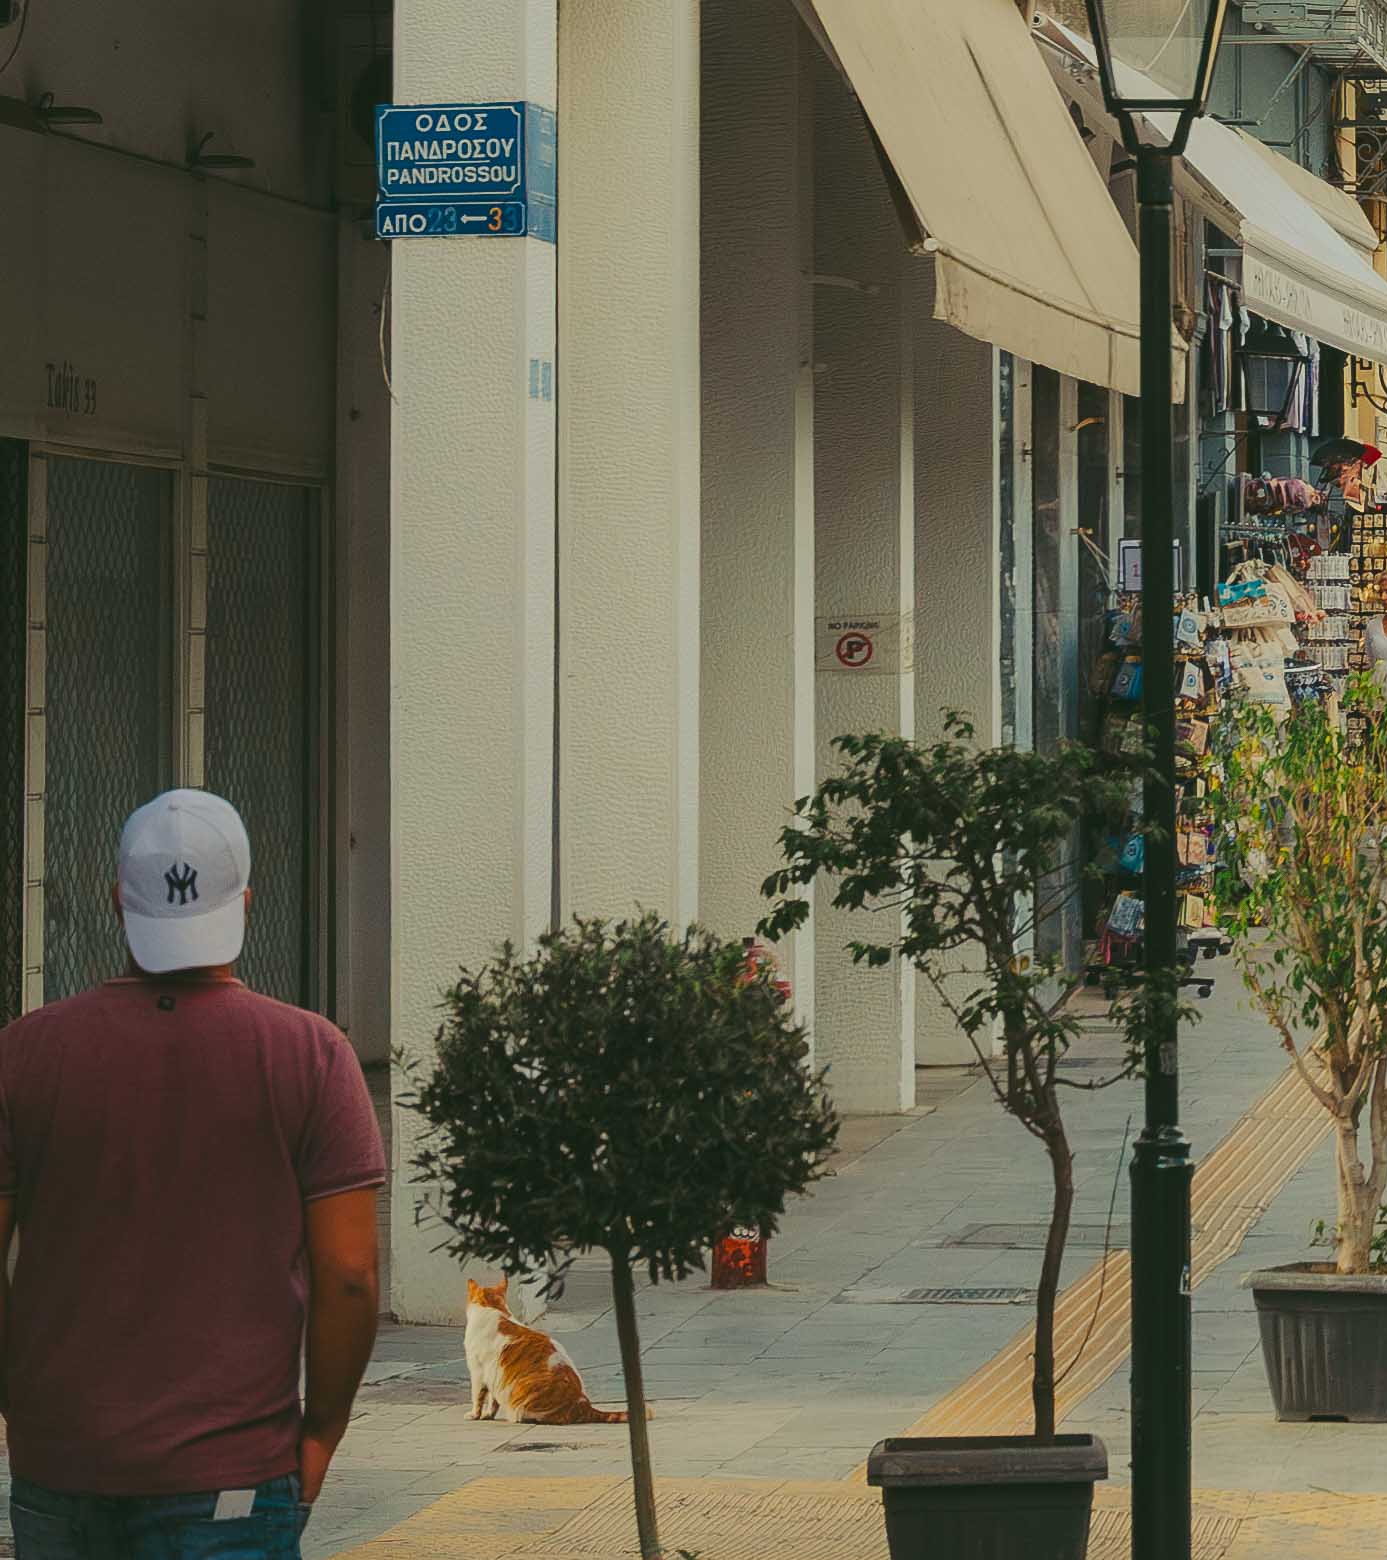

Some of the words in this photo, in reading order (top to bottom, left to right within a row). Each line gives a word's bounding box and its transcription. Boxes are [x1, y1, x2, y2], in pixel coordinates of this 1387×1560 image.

[415, 113, 488, 132] ΟΔΟΣ
[387, 138, 515, 161] ΠΑΝΔΡΟΣΟΥ
[387, 165, 516, 185] PANDROSSOU
[382, 213, 427, 233] ΑΠΟ
[828, 622, 841, 630] NO
